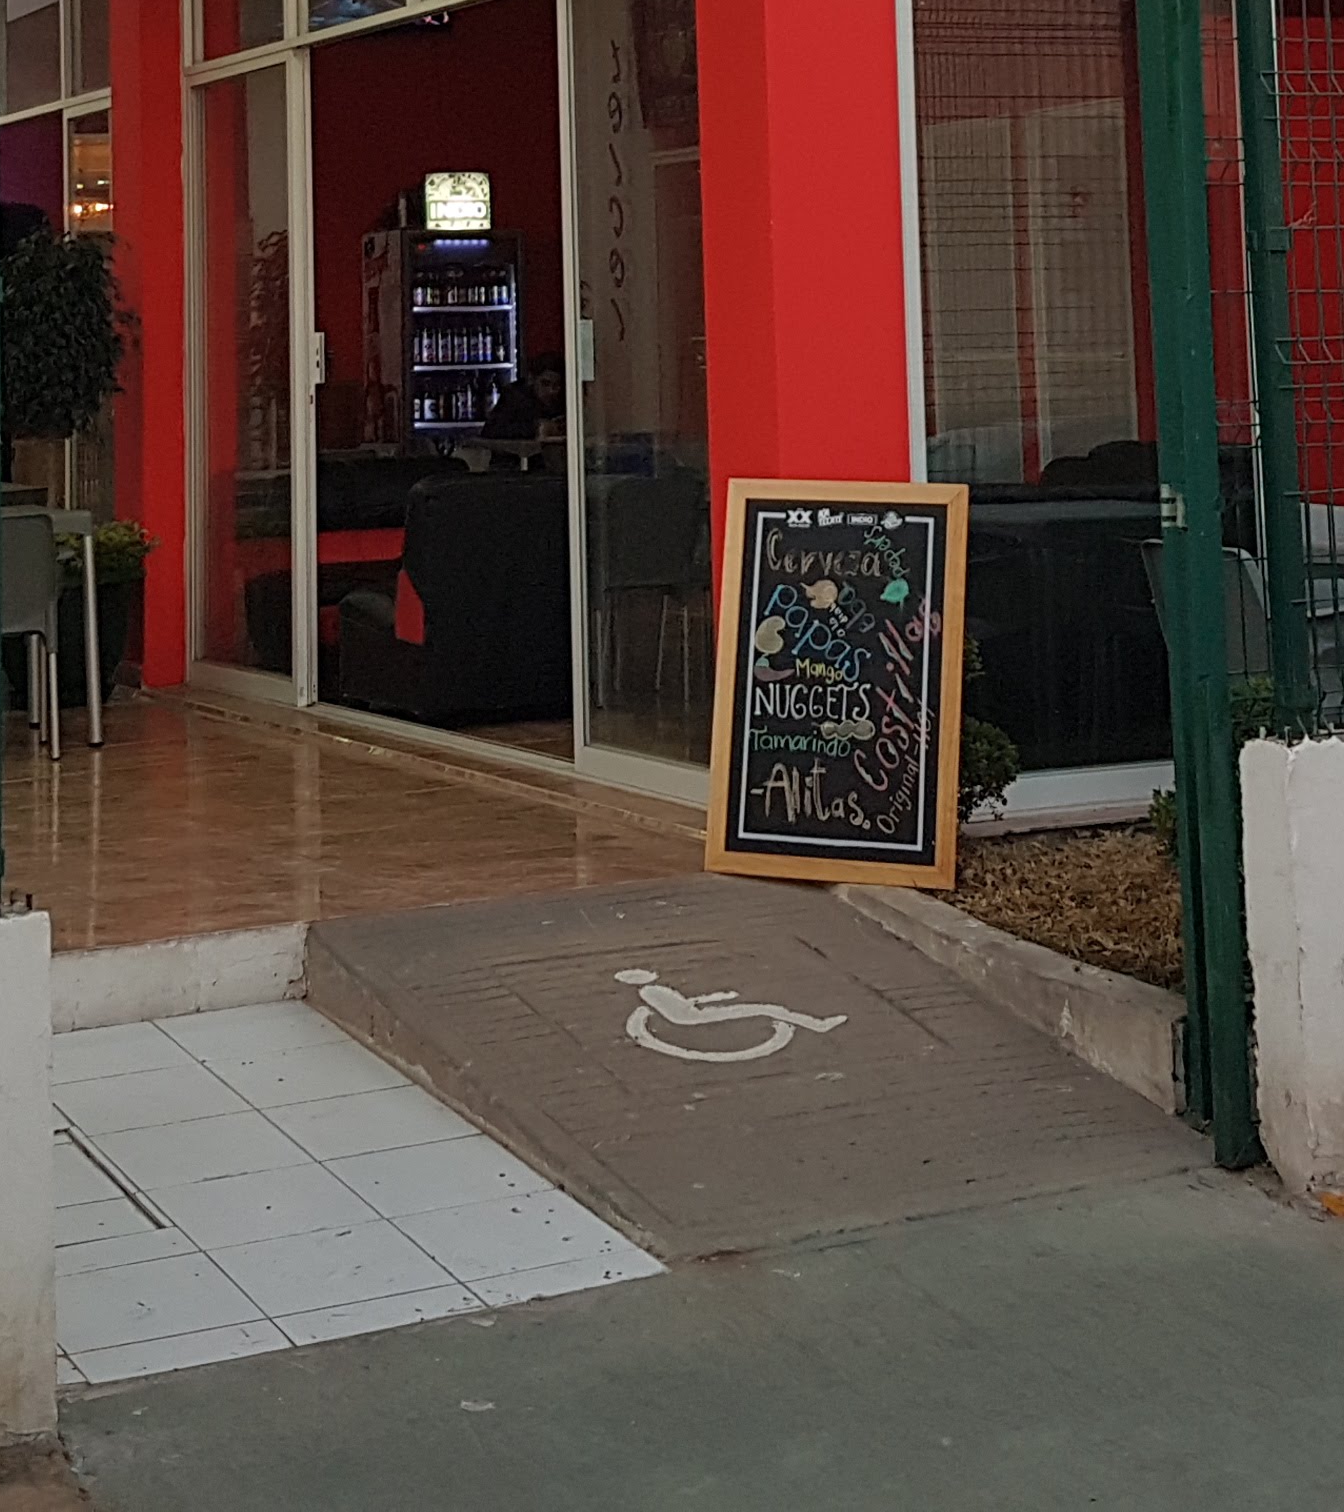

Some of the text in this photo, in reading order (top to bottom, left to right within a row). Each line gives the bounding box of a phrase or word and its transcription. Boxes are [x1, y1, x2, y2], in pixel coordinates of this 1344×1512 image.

[766, 528, 882, 577] Cerveza
[795, 657, 844, 685] Mango
[753, 681, 872, 721] NUGGETS
[749, 725, 851, 758] Tamarindo
